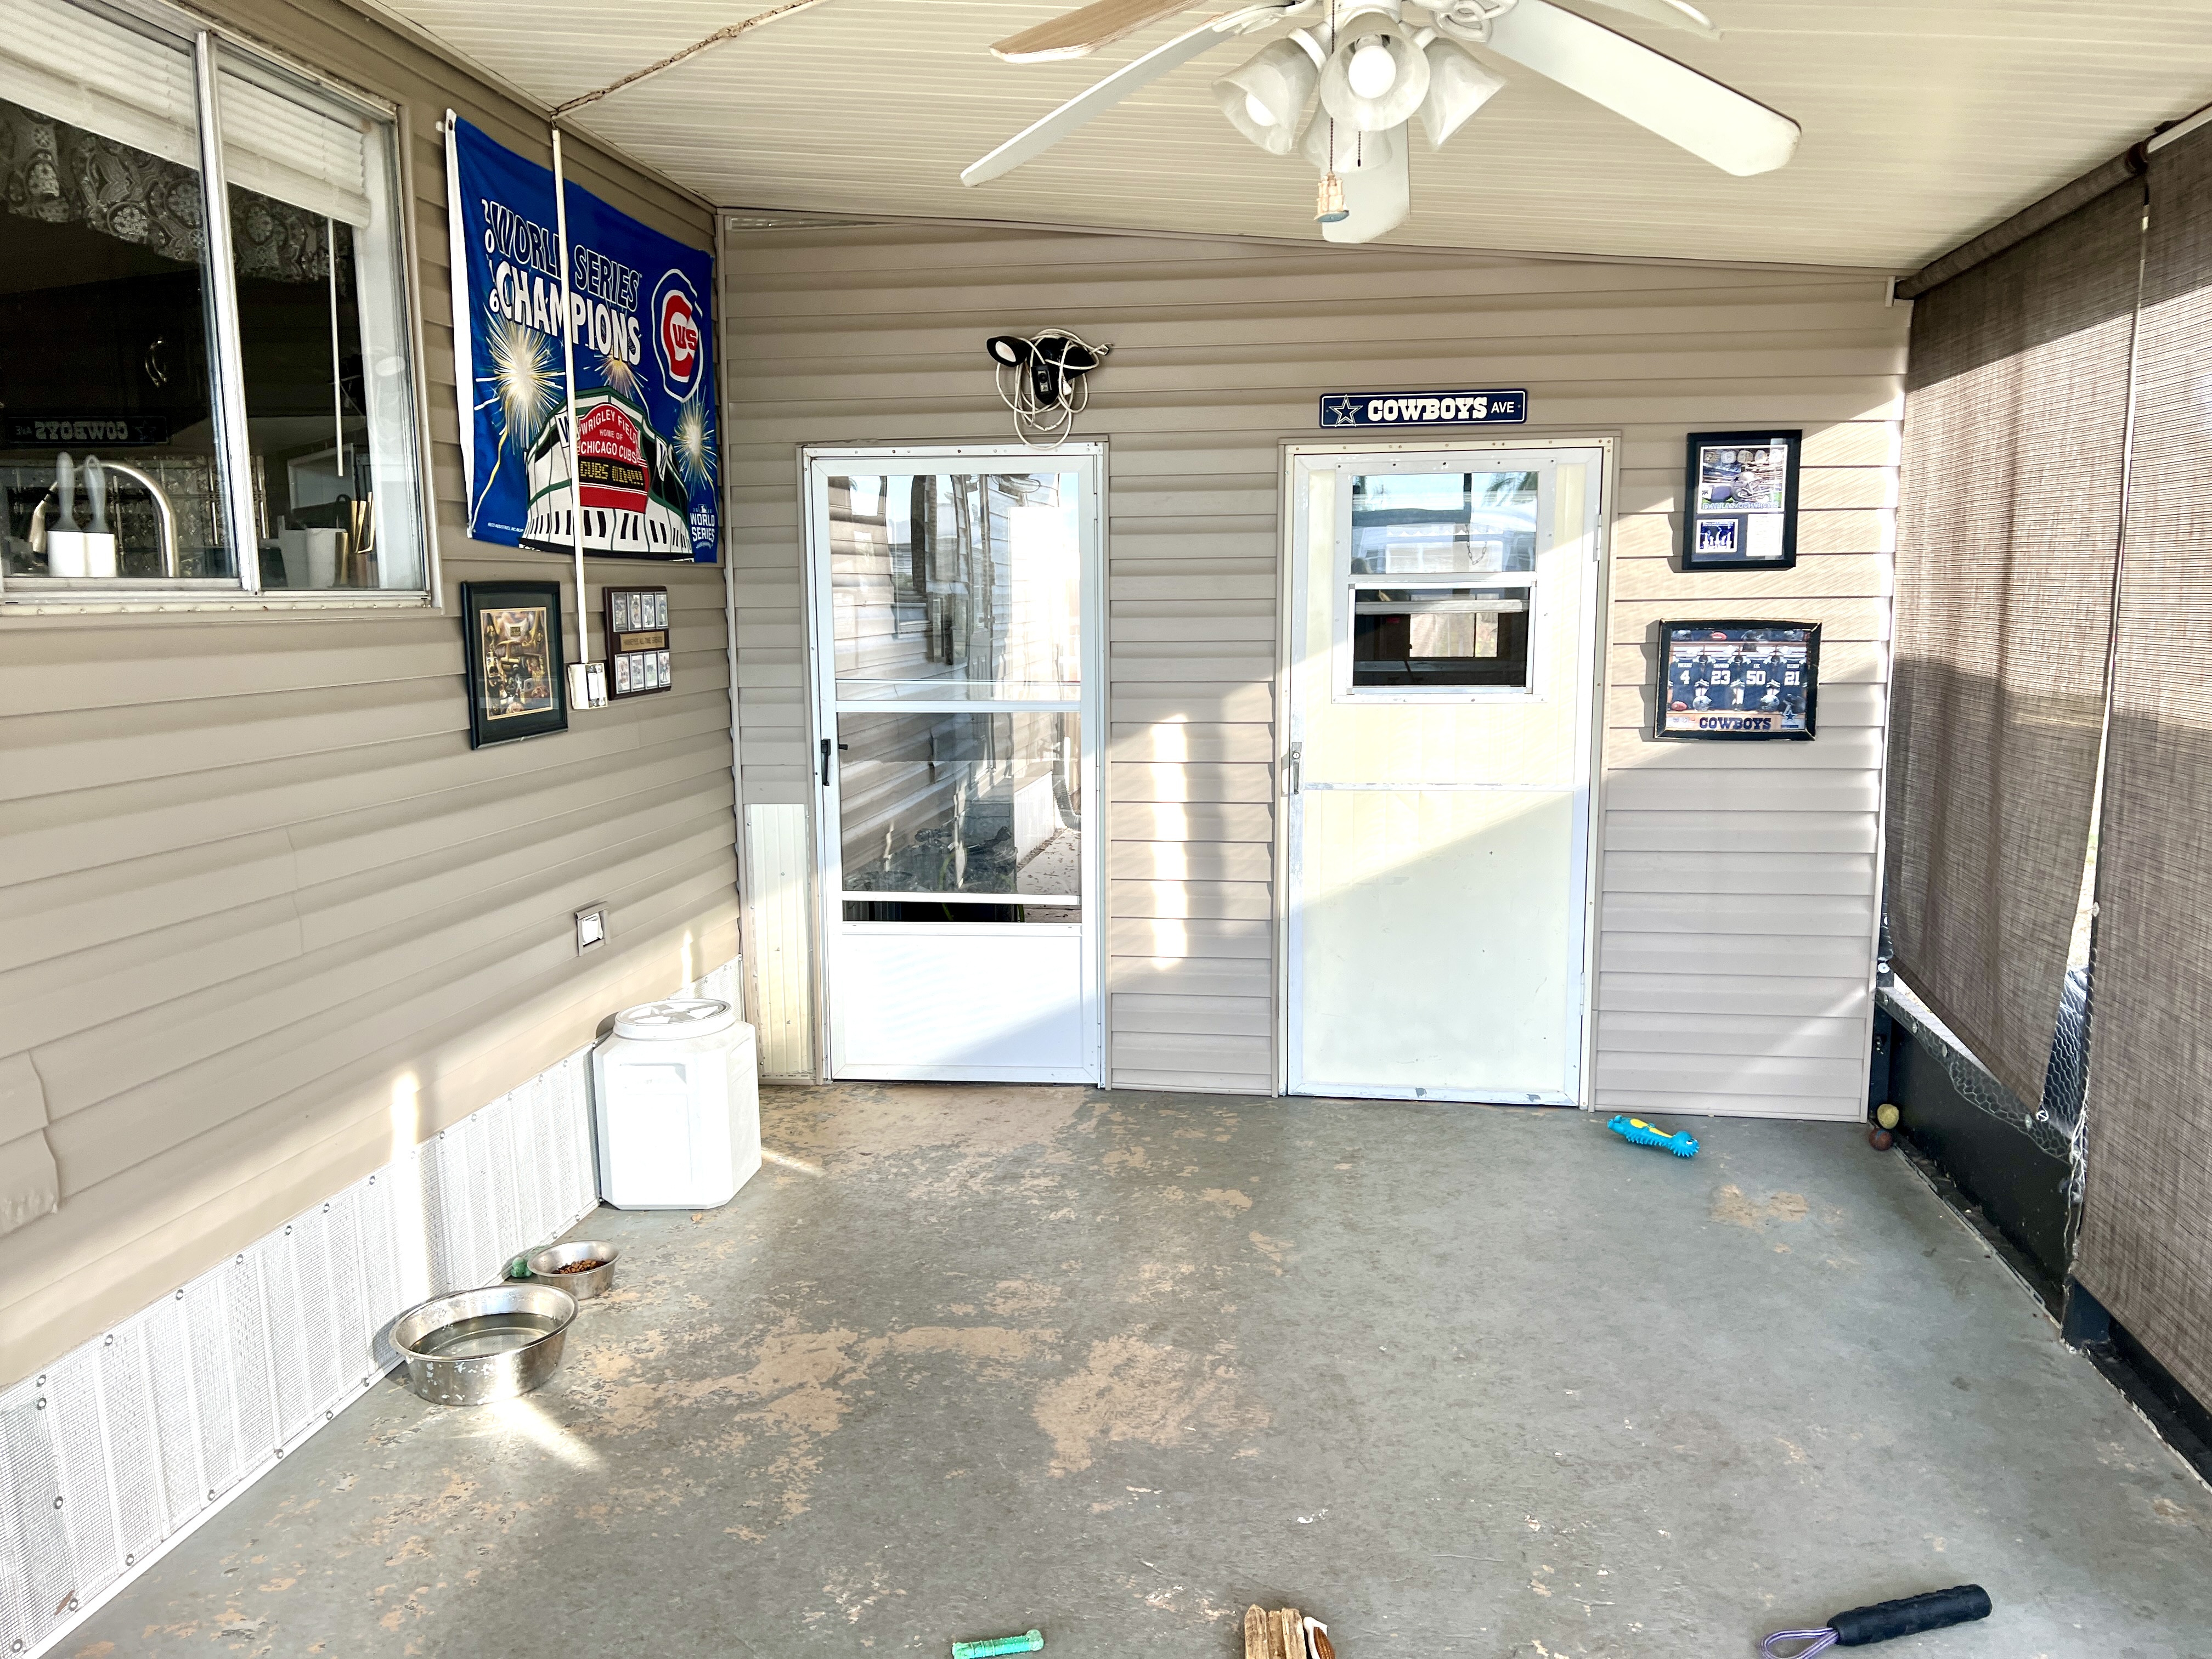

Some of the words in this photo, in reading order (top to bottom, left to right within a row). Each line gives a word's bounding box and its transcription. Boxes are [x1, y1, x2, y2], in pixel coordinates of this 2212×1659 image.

[574, 245, 639, 312] SERIES
[1368, 397, 1487, 421] COWBOYS
[1491, 402, 1514, 413] AVE
[580, 409, 616, 435] WRIGLEY
[618, 415, 636, 444] FIELD
[599, 429, 614, 438] HOME
[616, 432, 623, 441] OF
[580, 441, 617, 456] CHICAGO
[619, 445, 637, 464] CUBS
[580, 461, 609, 479] CUBS
[690, 512, 715, 527] WORLD
[691, 526, 715, 543] SERIES
[1680, 670, 1690, 685] 4
[1711, 670, 1731, 685] 23
[1746, 670, 1766, 685] 50
[1784, 670, 1801, 686] 21
[1699, 717, 1771, 730] COWBOYS
